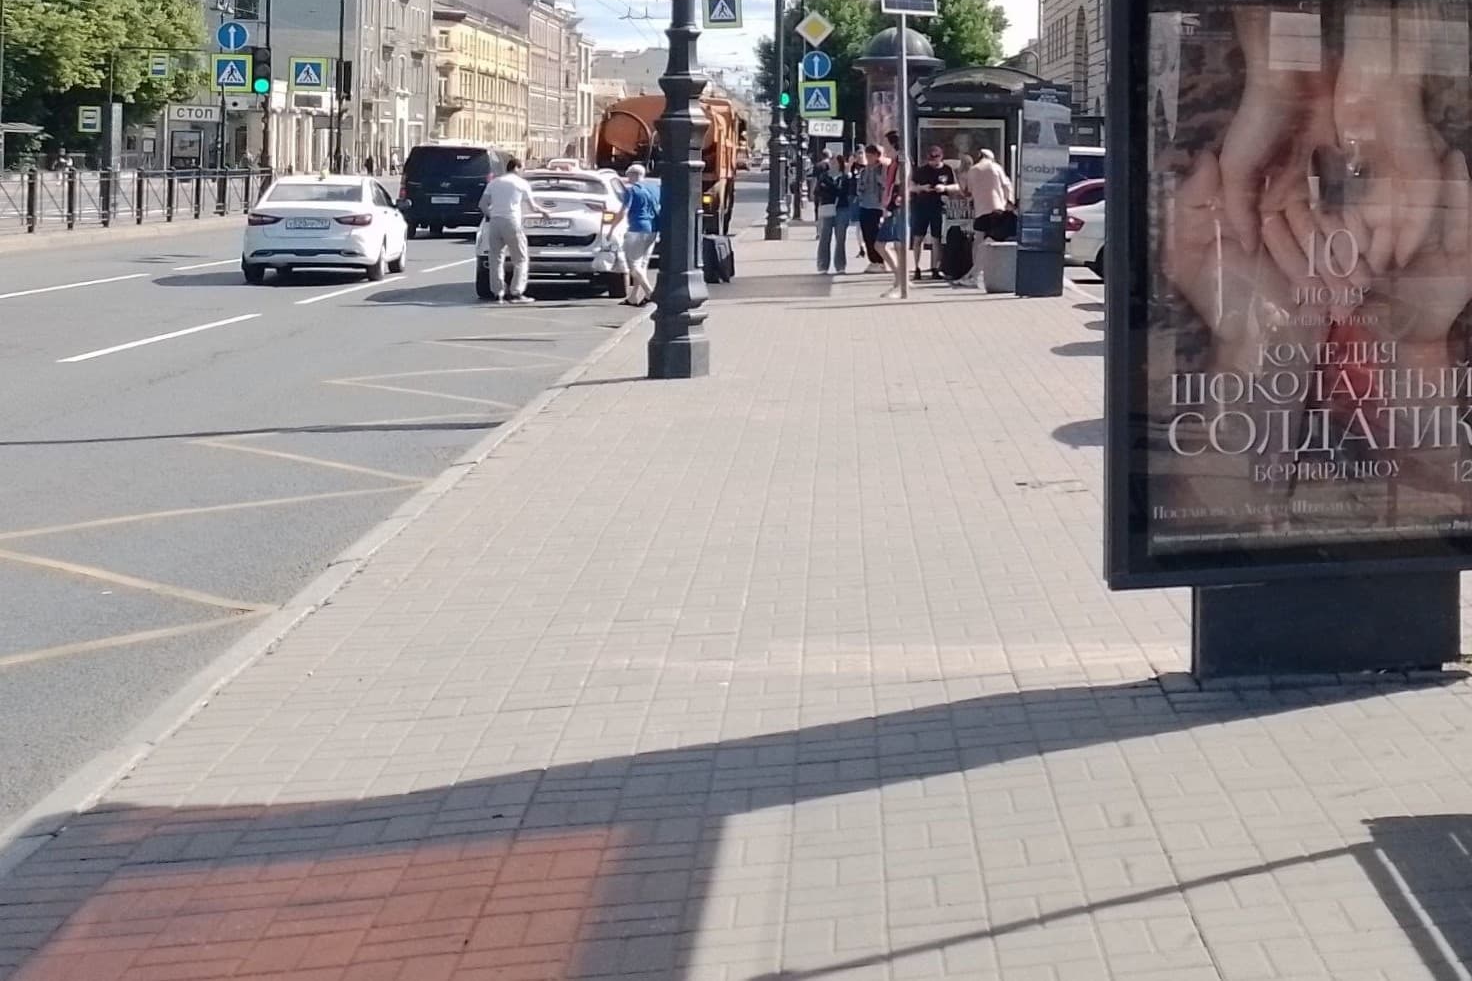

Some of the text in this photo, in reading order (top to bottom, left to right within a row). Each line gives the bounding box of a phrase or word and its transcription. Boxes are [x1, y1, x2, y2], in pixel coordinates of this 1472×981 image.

[176, 107, 213, 119] СТОП
[813, 122, 839, 132] СТОП
[1306, 228, 1359, 278] 10
[1257, 340, 1398, 368] КОМЕДИЯ
[1354, 459, 1400, 477] ШОУ
